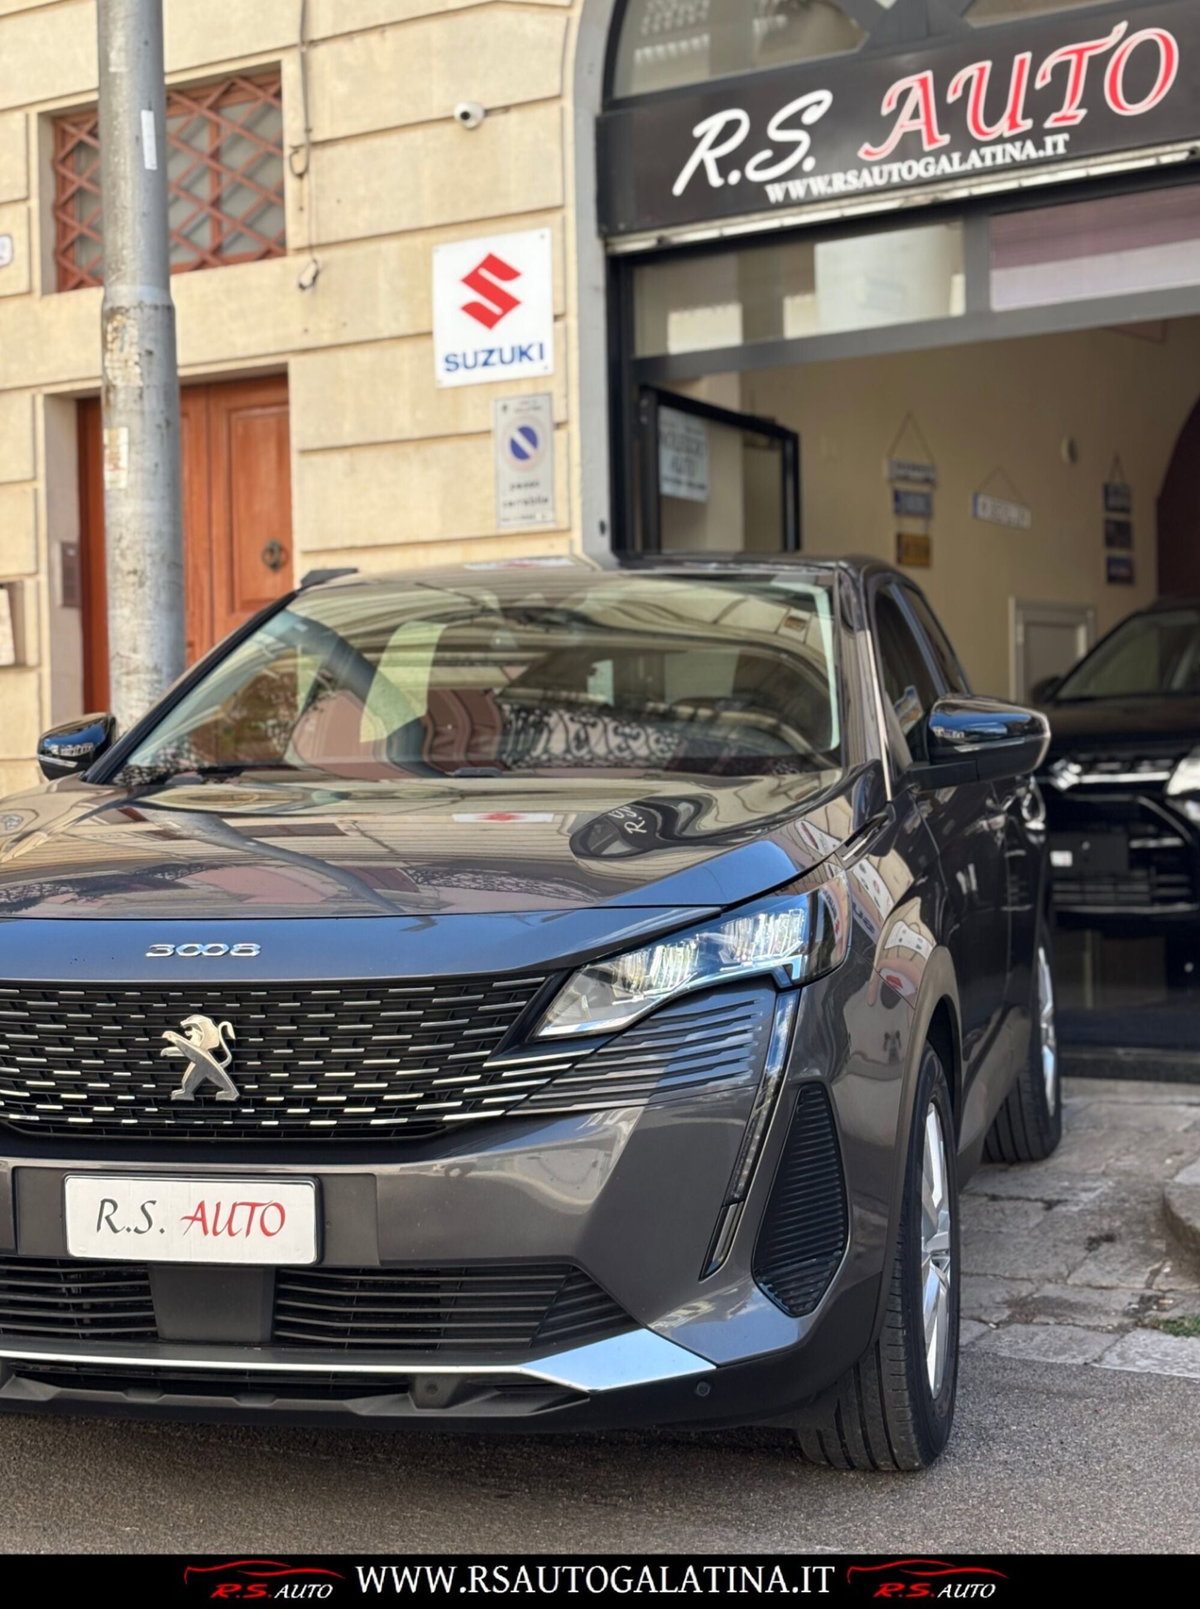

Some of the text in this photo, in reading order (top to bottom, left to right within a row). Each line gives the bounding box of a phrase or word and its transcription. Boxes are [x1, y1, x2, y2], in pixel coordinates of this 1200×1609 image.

[672, 20, 1179, 196] R.S. AUTO
[764, 134, 1069, 204] WWW.RSAUTOGALATINA.IT
[444, 342, 545, 372] SUZUKI
[145, 943, 261, 957] 3008
[96, 1198, 286, 1238] R.S. AUTO
